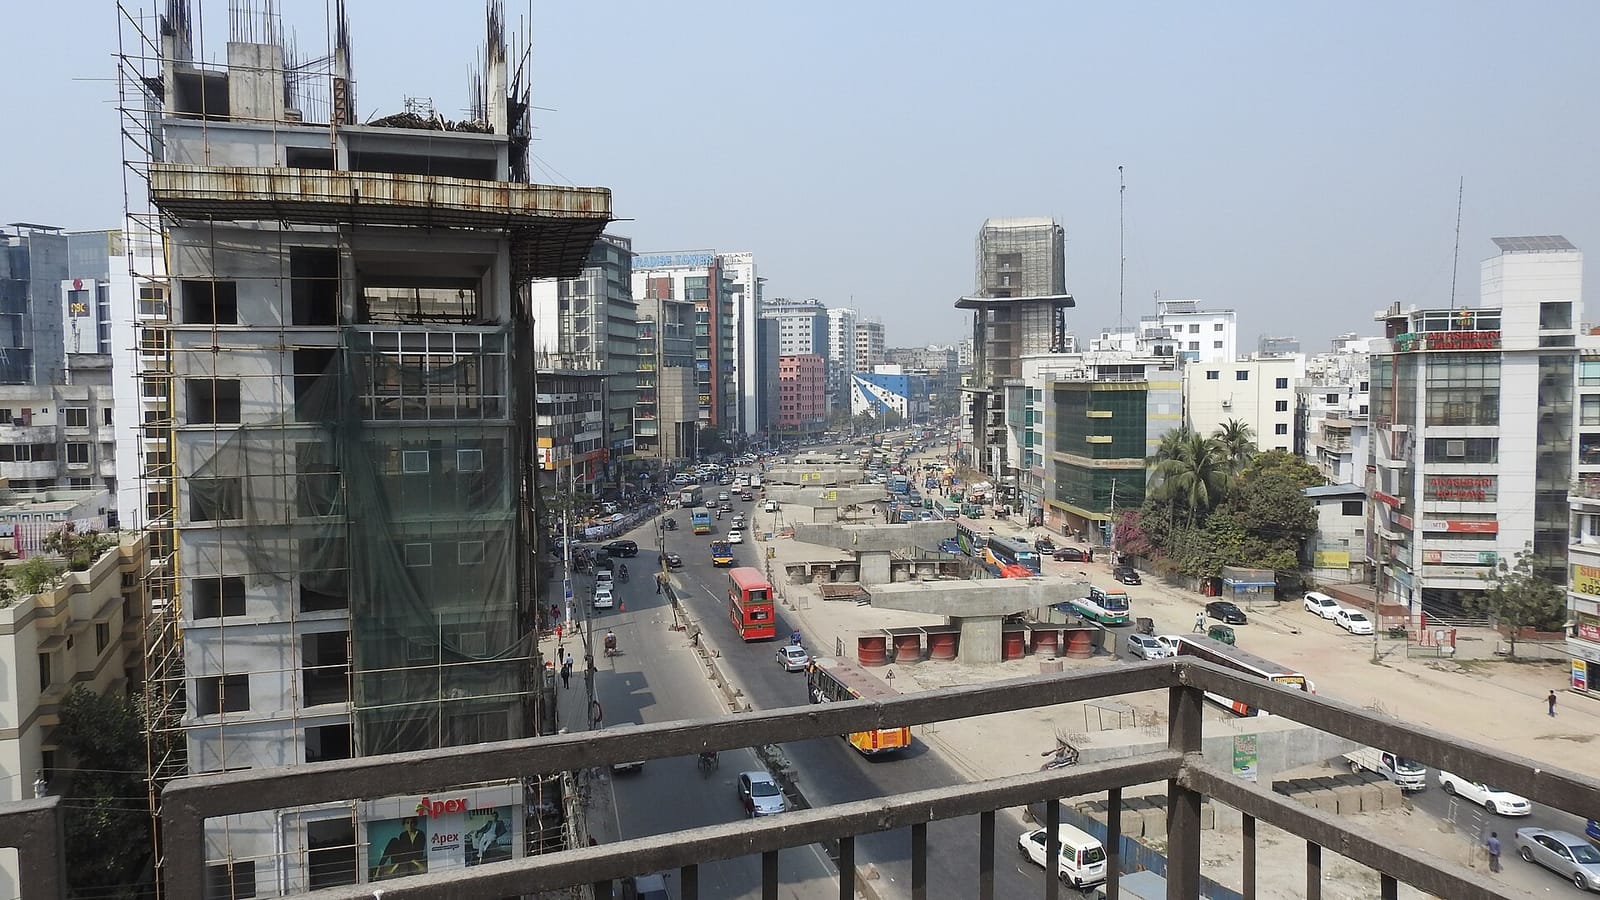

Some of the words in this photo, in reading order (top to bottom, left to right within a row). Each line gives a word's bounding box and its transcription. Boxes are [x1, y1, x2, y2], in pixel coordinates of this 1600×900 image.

[674, 254, 714, 267] TOWER
[416, 797, 467, 819] Apex
[431, 832, 459, 846] Apex
